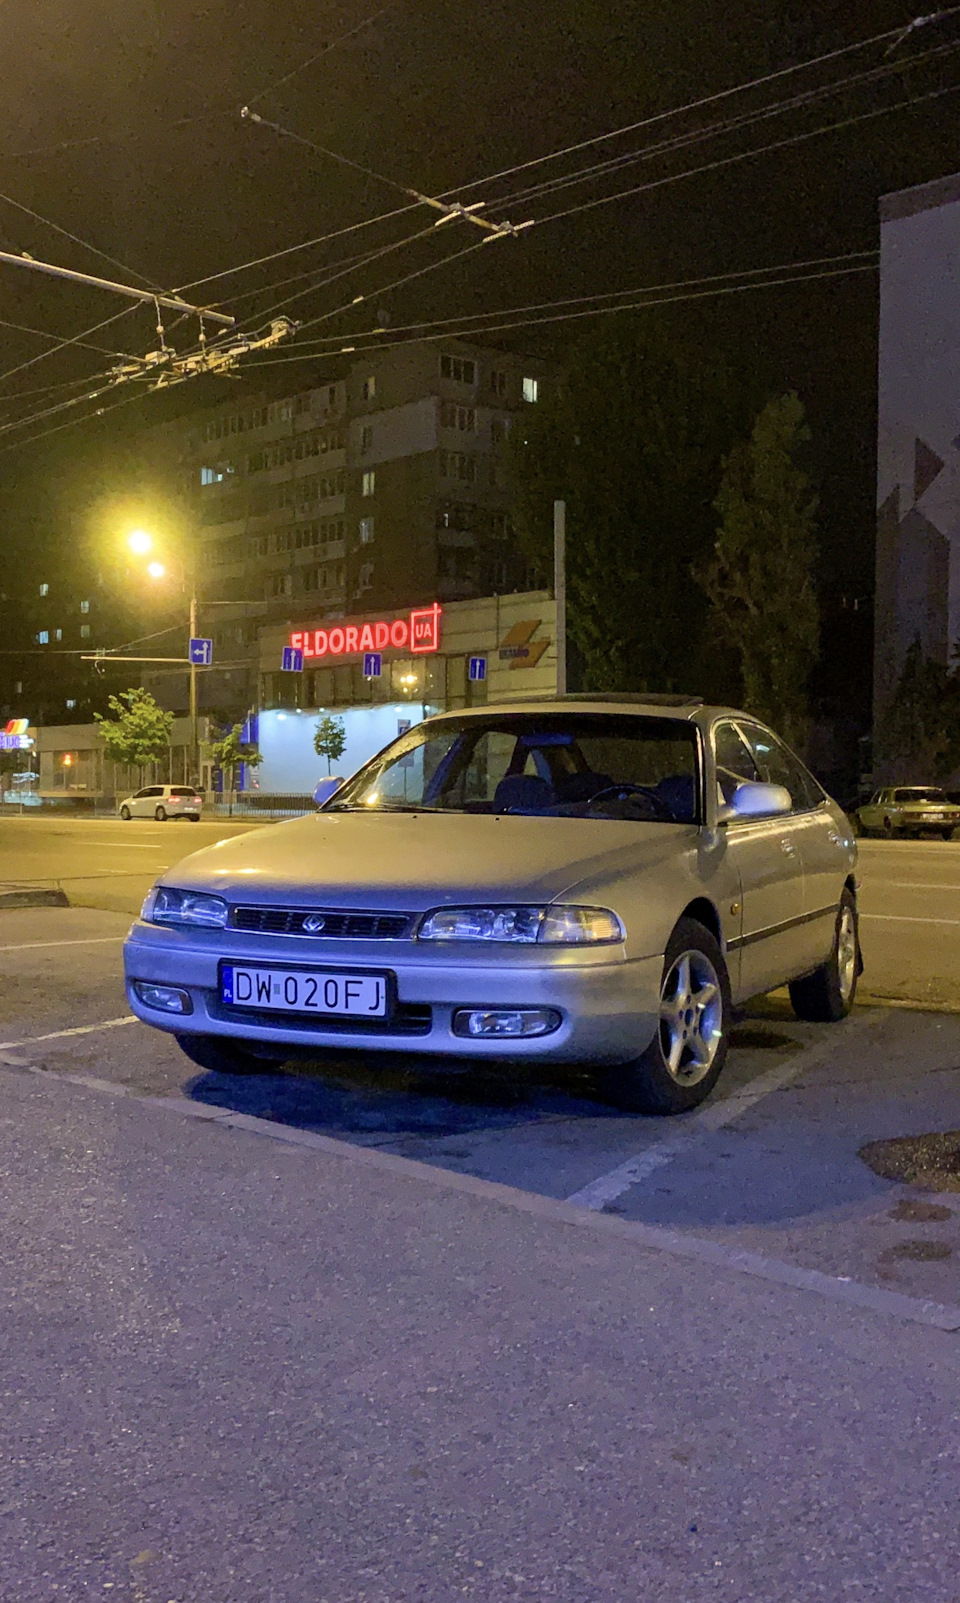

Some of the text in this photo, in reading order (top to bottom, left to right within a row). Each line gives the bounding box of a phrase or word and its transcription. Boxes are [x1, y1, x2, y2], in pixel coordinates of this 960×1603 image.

[290, 619, 432, 657] ELDORADO UA
[223, 988, 232, 998] PL
